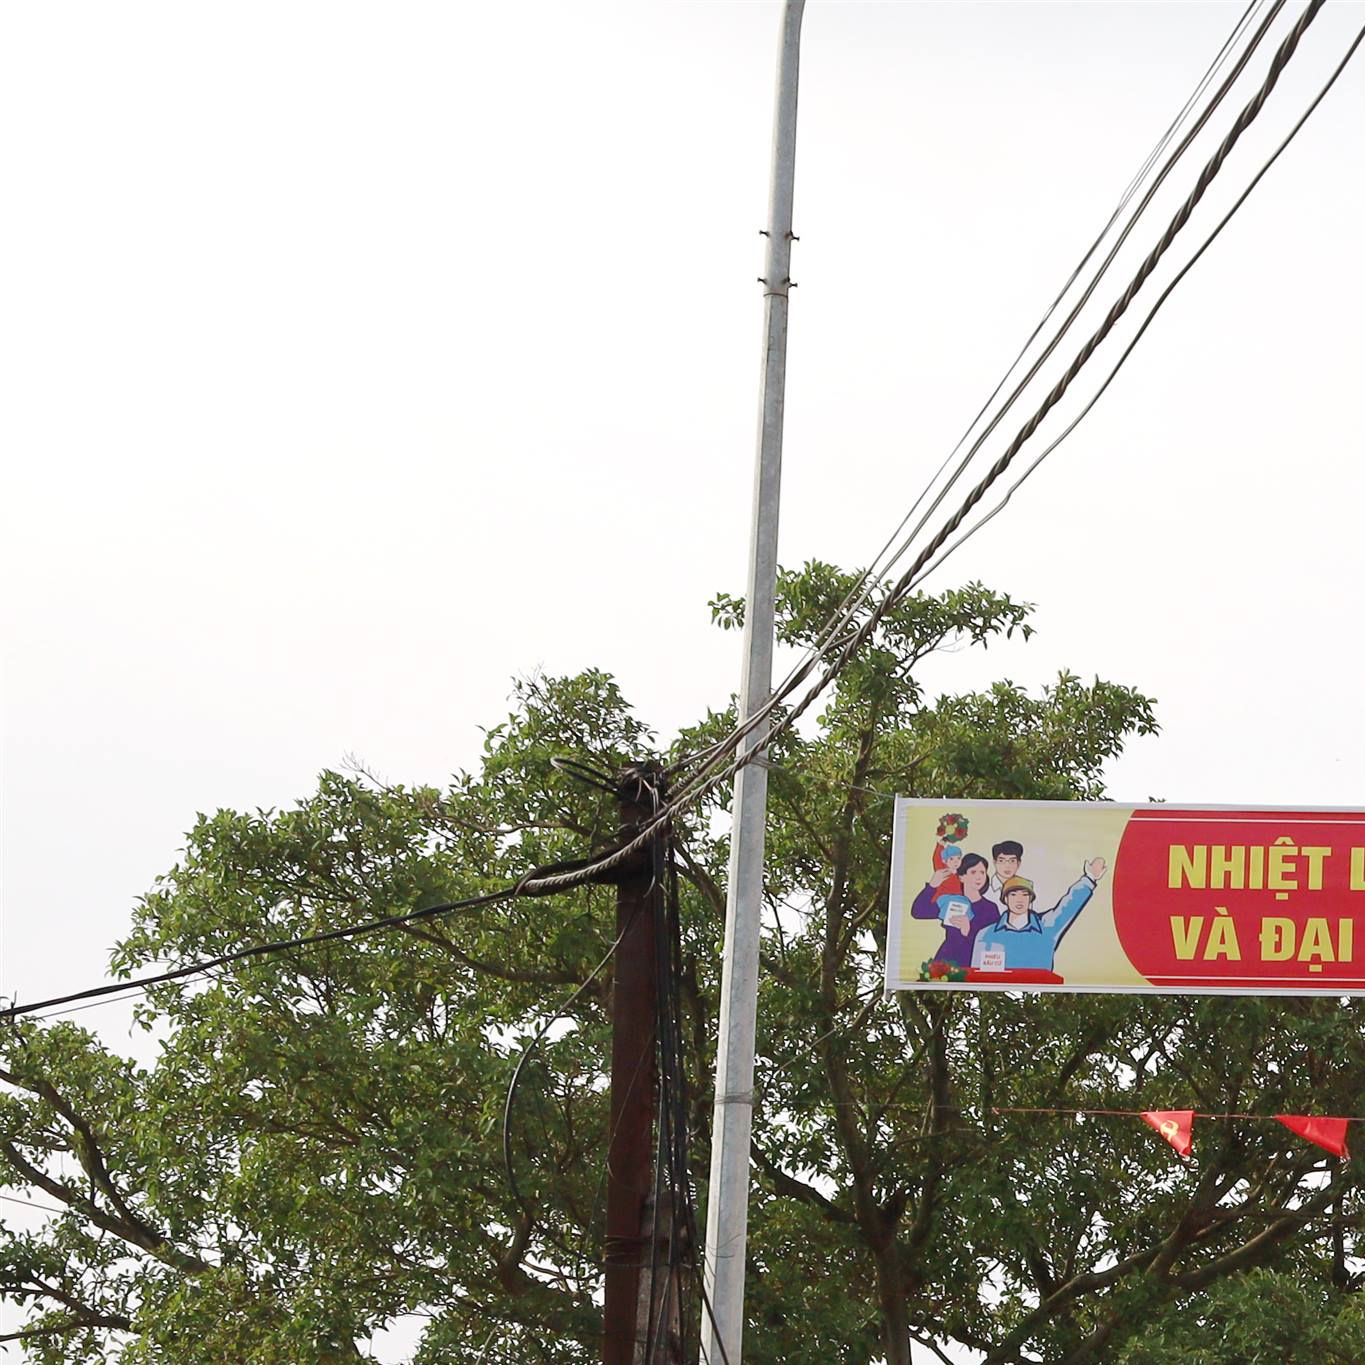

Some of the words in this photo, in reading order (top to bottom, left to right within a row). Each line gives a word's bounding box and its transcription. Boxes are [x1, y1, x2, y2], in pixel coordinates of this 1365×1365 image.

[1167, 836, 1331, 900] NHIỆT
[1169, 906, 1242, 962] VÀ
[1258, 915, 1354, 972] ĐẠI
